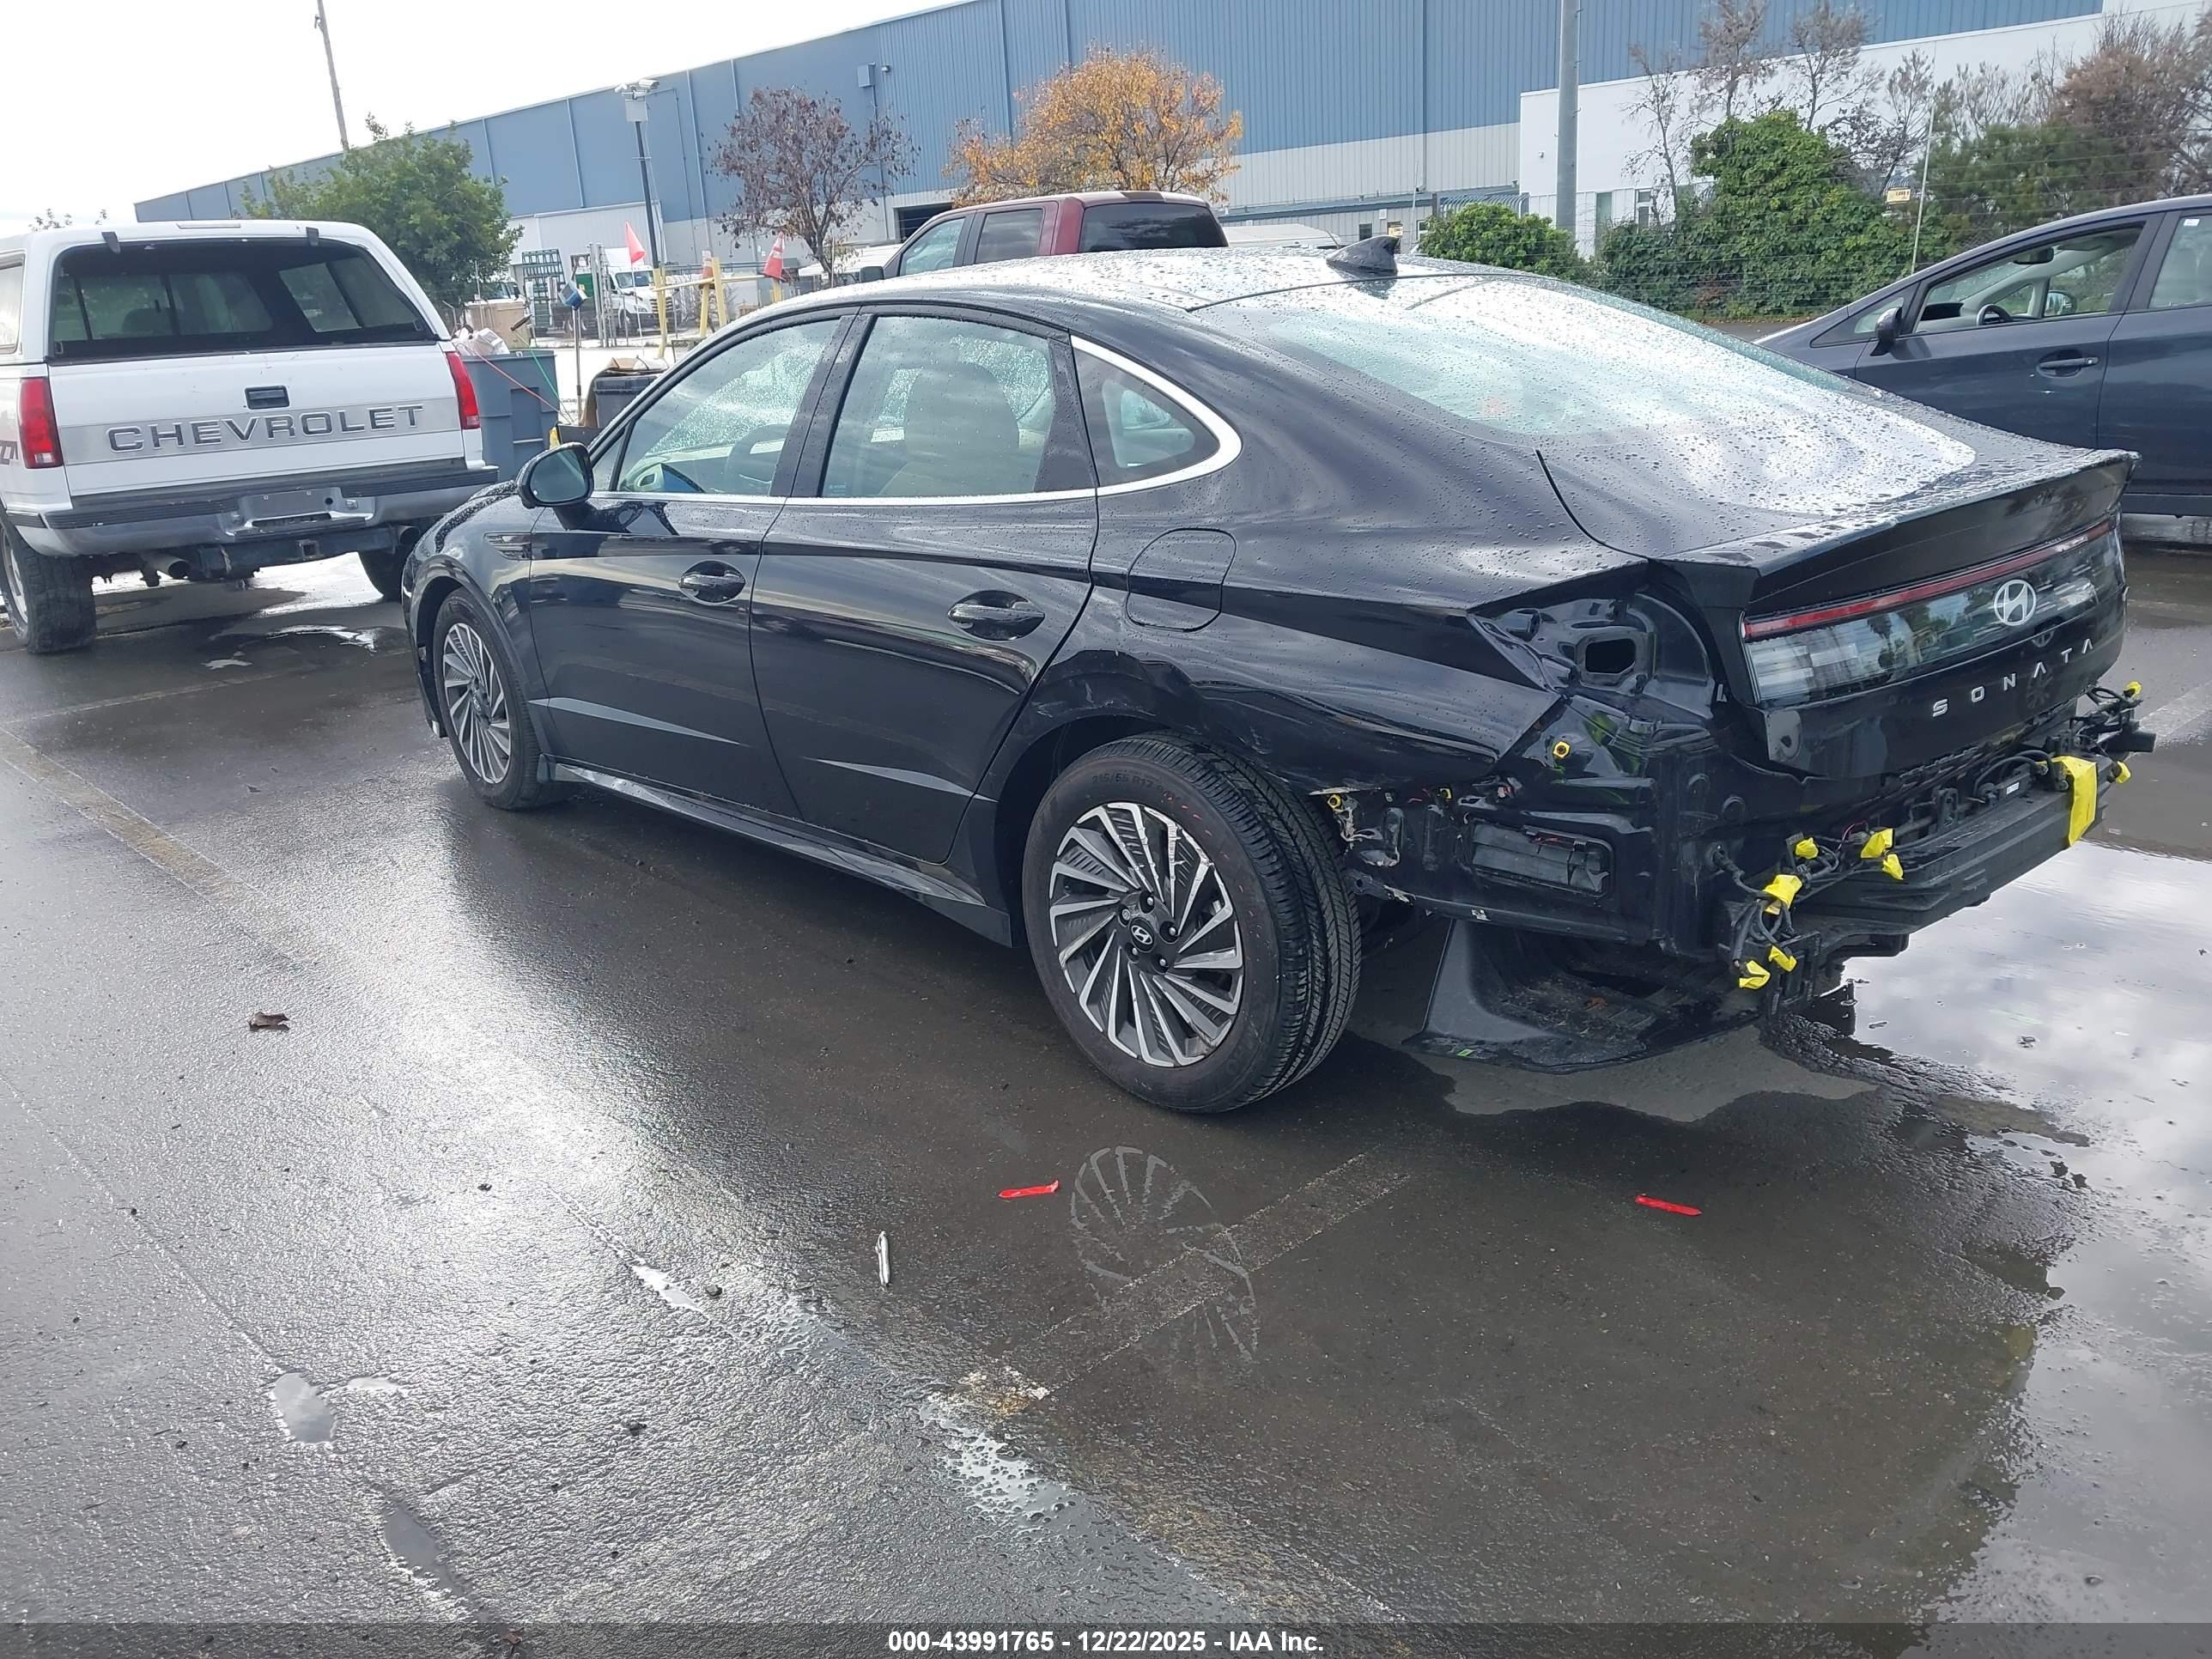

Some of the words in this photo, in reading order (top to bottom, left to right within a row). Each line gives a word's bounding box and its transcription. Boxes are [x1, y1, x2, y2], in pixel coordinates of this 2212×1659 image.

[106, 404, 423, 453] CHEVROLET
[1932, 638, 2094, 717] SONATA
[1131, 775, 1154, 788] R17
